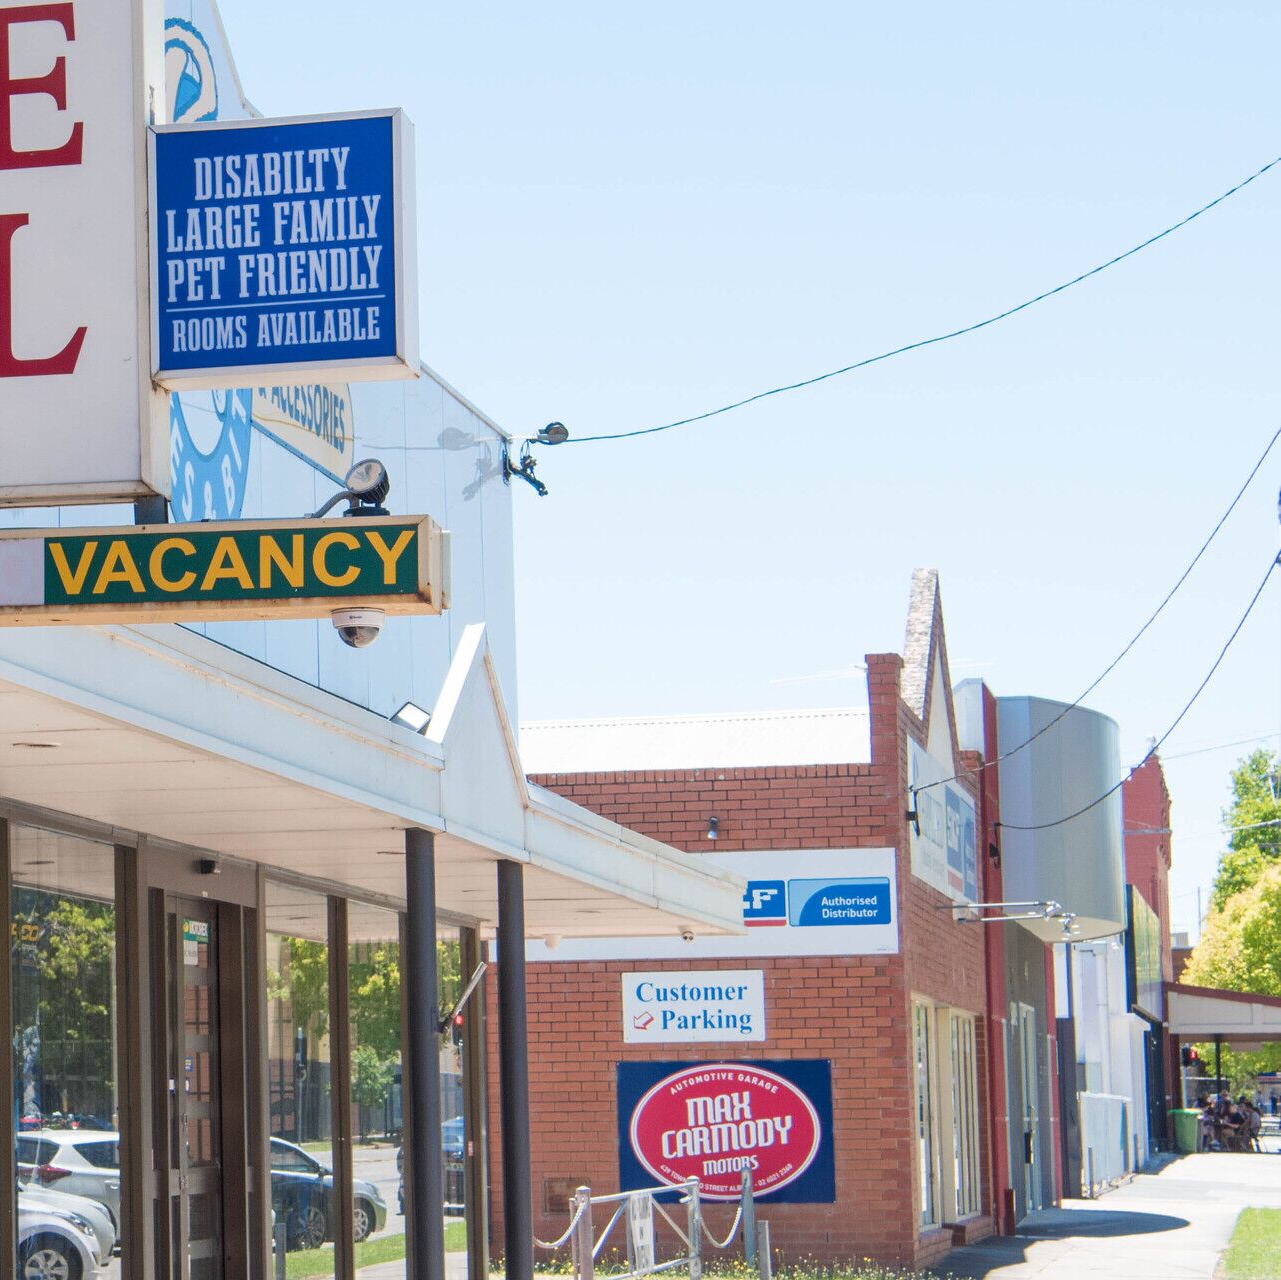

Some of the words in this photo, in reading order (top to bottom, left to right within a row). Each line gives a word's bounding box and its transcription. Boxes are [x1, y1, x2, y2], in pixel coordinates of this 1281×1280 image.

[194, 146, 350, 201] DISABILTY
[165, 203, 261, 253] LARGE
[272, 194, 381, 246] FAMILY
[166, 256, 226, 303] PET
[238, 245, 383, 298] FRIENDLY
[172, 315, 247, 353] ROOMS
[256, 306, 380, 347] AVAILABLE
[48, 530, 416, 596] VACANCY
[821, 895, 877, 906] Authorised
[822, 907, 878, 919] Distributor
[635, 982, 748, 1003] Customer
[661, 1009, 753, 1035] Parking
[670, 1072, 734, 1096] AUTOMOTIVE
[737, 1072, 779, 1094] GARAGE
[685, 1090, 752, 1127] MAX
[661, 1115, 793, 1159] CARMODY
[702, 1154, 760, 1176] MOTORS
